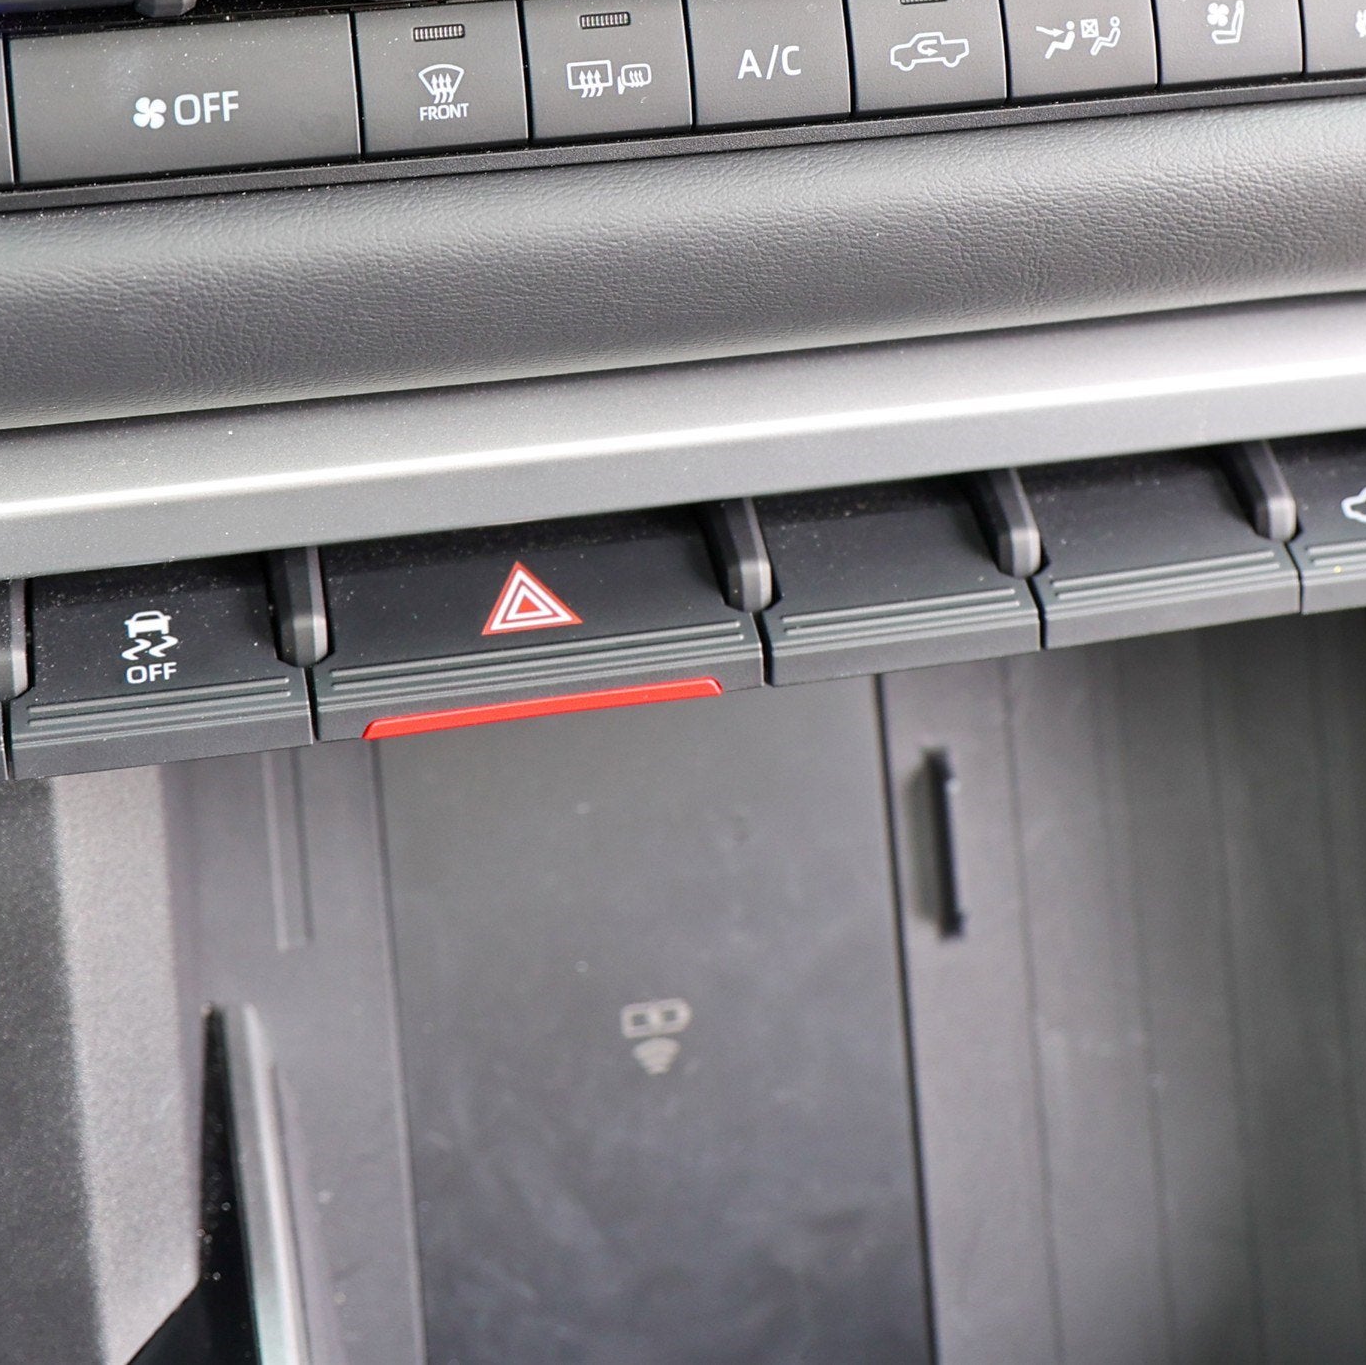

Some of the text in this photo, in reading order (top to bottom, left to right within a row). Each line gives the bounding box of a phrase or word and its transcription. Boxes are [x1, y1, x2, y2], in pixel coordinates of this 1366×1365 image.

[737, 44, 802, 80] A/C
[174, 90, 239, 126] OFF
[419, 102, 470, 121] FRONT
[125, 660, 177, 684] OFF
